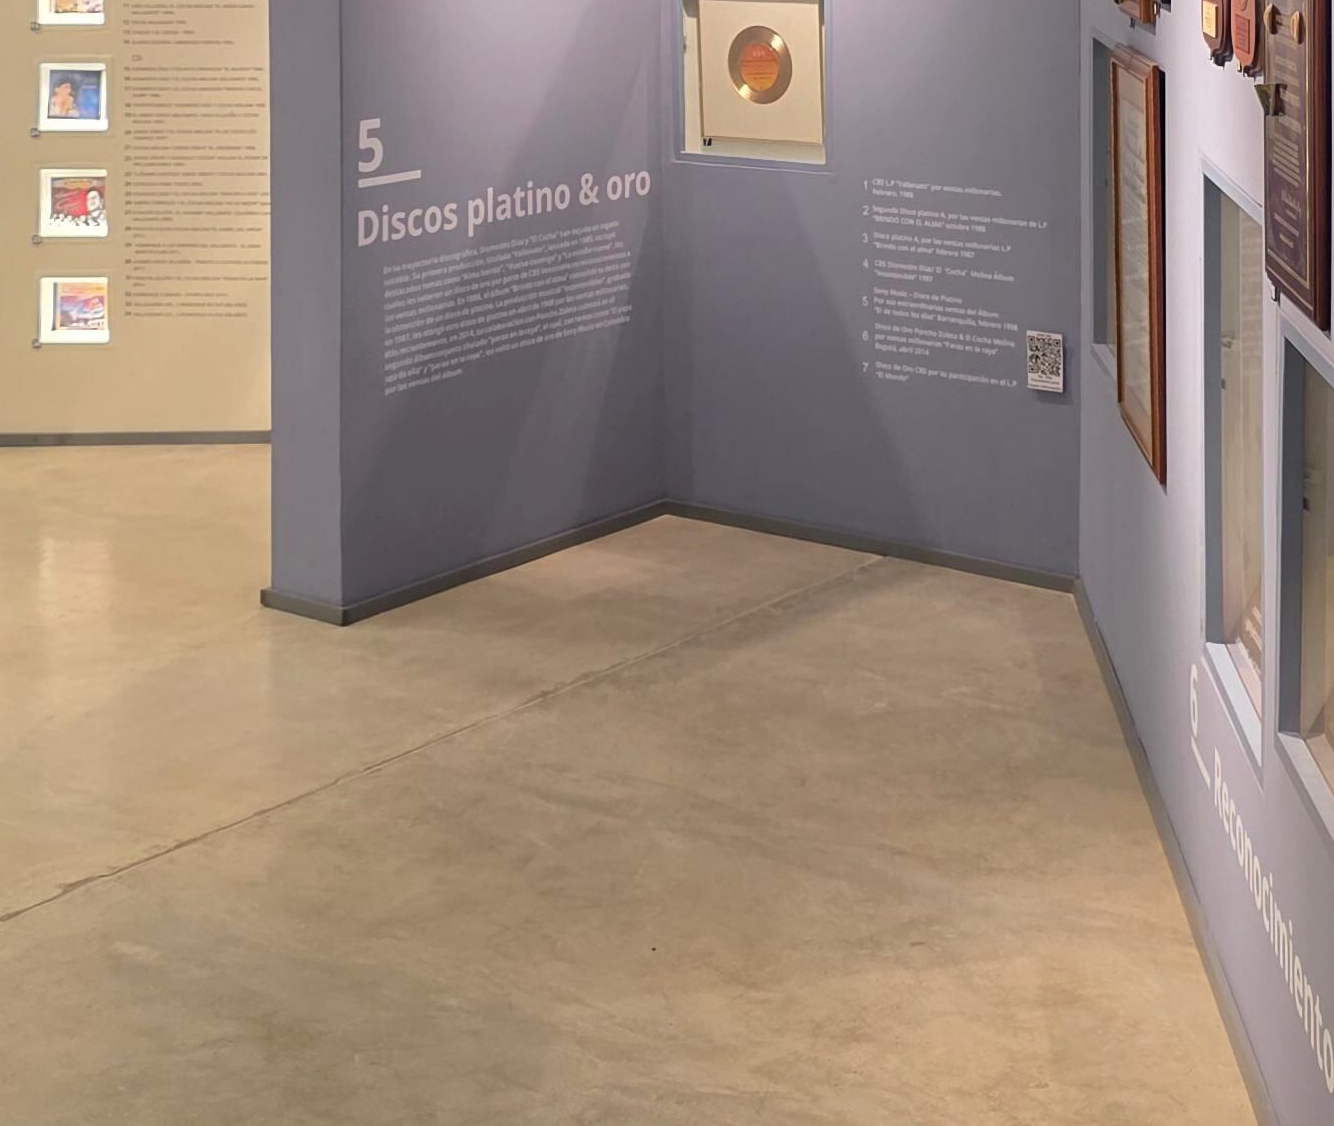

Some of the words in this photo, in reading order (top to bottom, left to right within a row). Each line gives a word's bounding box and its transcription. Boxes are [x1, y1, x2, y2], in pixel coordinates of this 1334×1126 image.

[358, 118, 385, 173] 5
[357, 201, 458, 247] Discos
[468, 181, 571, 238] platino
[579, 172, 600, 206] &
[606, 170, 652, 201] oro
[862, 205, 869, 216] 2
[862, 233, 868, 243] 3
[862, 259, 869, 269] 4
[862, 296, 869, 307] 5
[862, 362, 869, 372] 7
